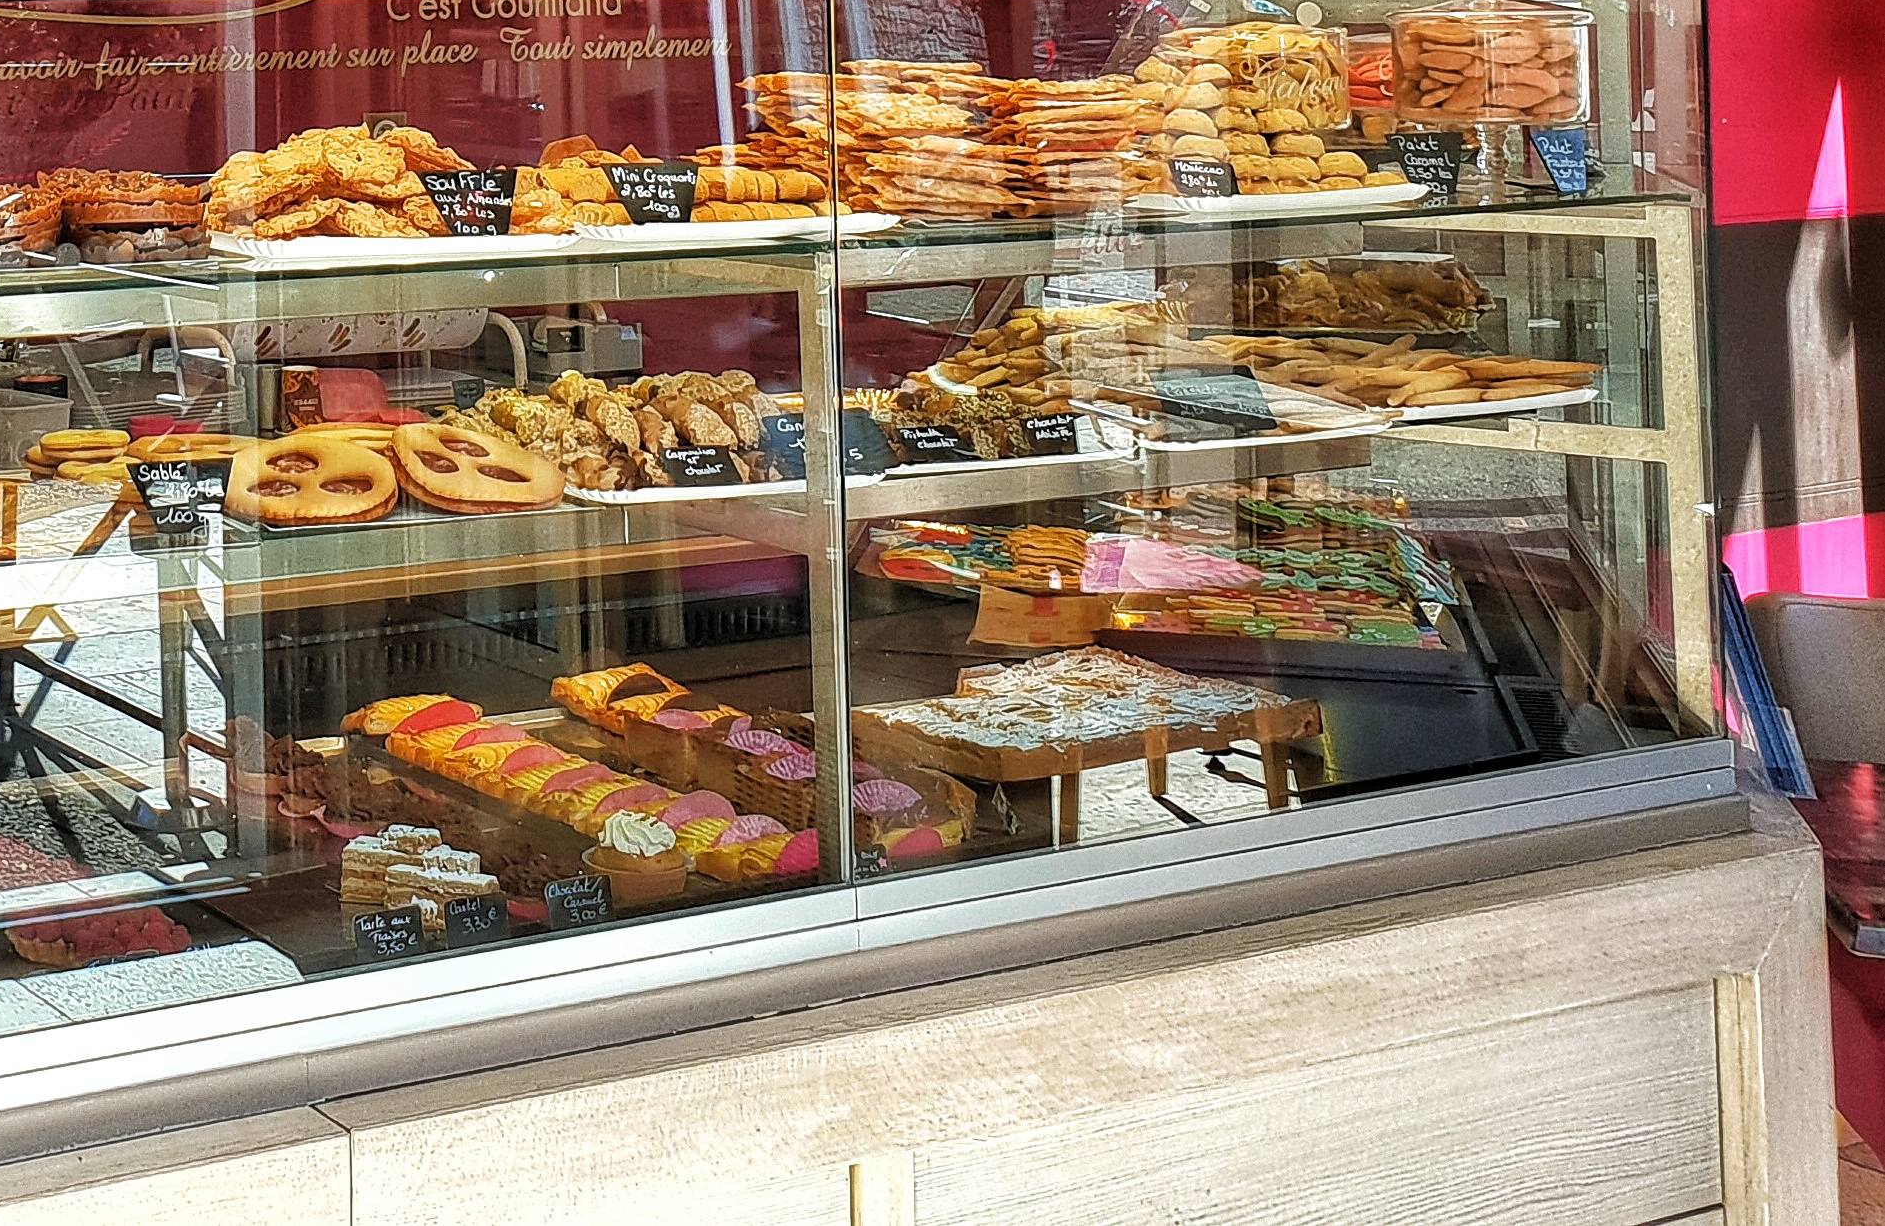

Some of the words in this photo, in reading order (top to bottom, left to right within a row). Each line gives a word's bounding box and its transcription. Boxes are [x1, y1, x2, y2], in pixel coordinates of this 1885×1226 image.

[175, 42, 342, 75] entièrement
[346, 42, 396, 68] sur
[401, 30, 480, 77] place
[499, 27, 576, 62] Tout
[137, 463, 187, 481] Sablé
[356, 914, 387, 931] Tarte
